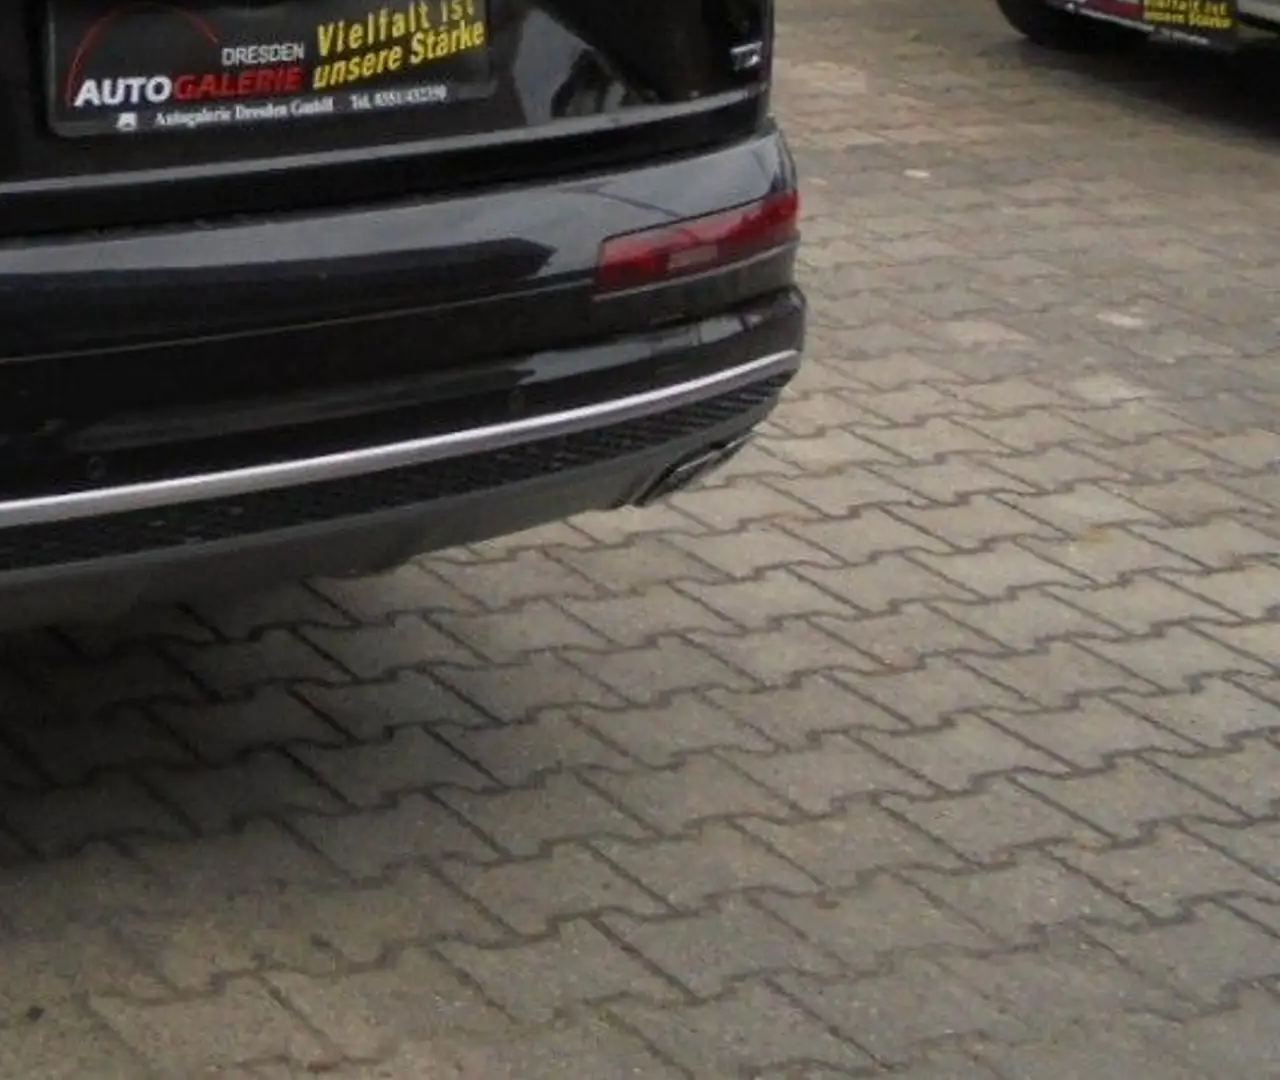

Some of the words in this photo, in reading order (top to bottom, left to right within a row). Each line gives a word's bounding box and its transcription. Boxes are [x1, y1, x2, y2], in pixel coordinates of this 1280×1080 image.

[221, 43, 305, 67] DRESDEN
[312, 45, 404, 90] unsere
[408, 21, 485, 65] Stärke
[316, 0, 430, 57] Vielfalt
